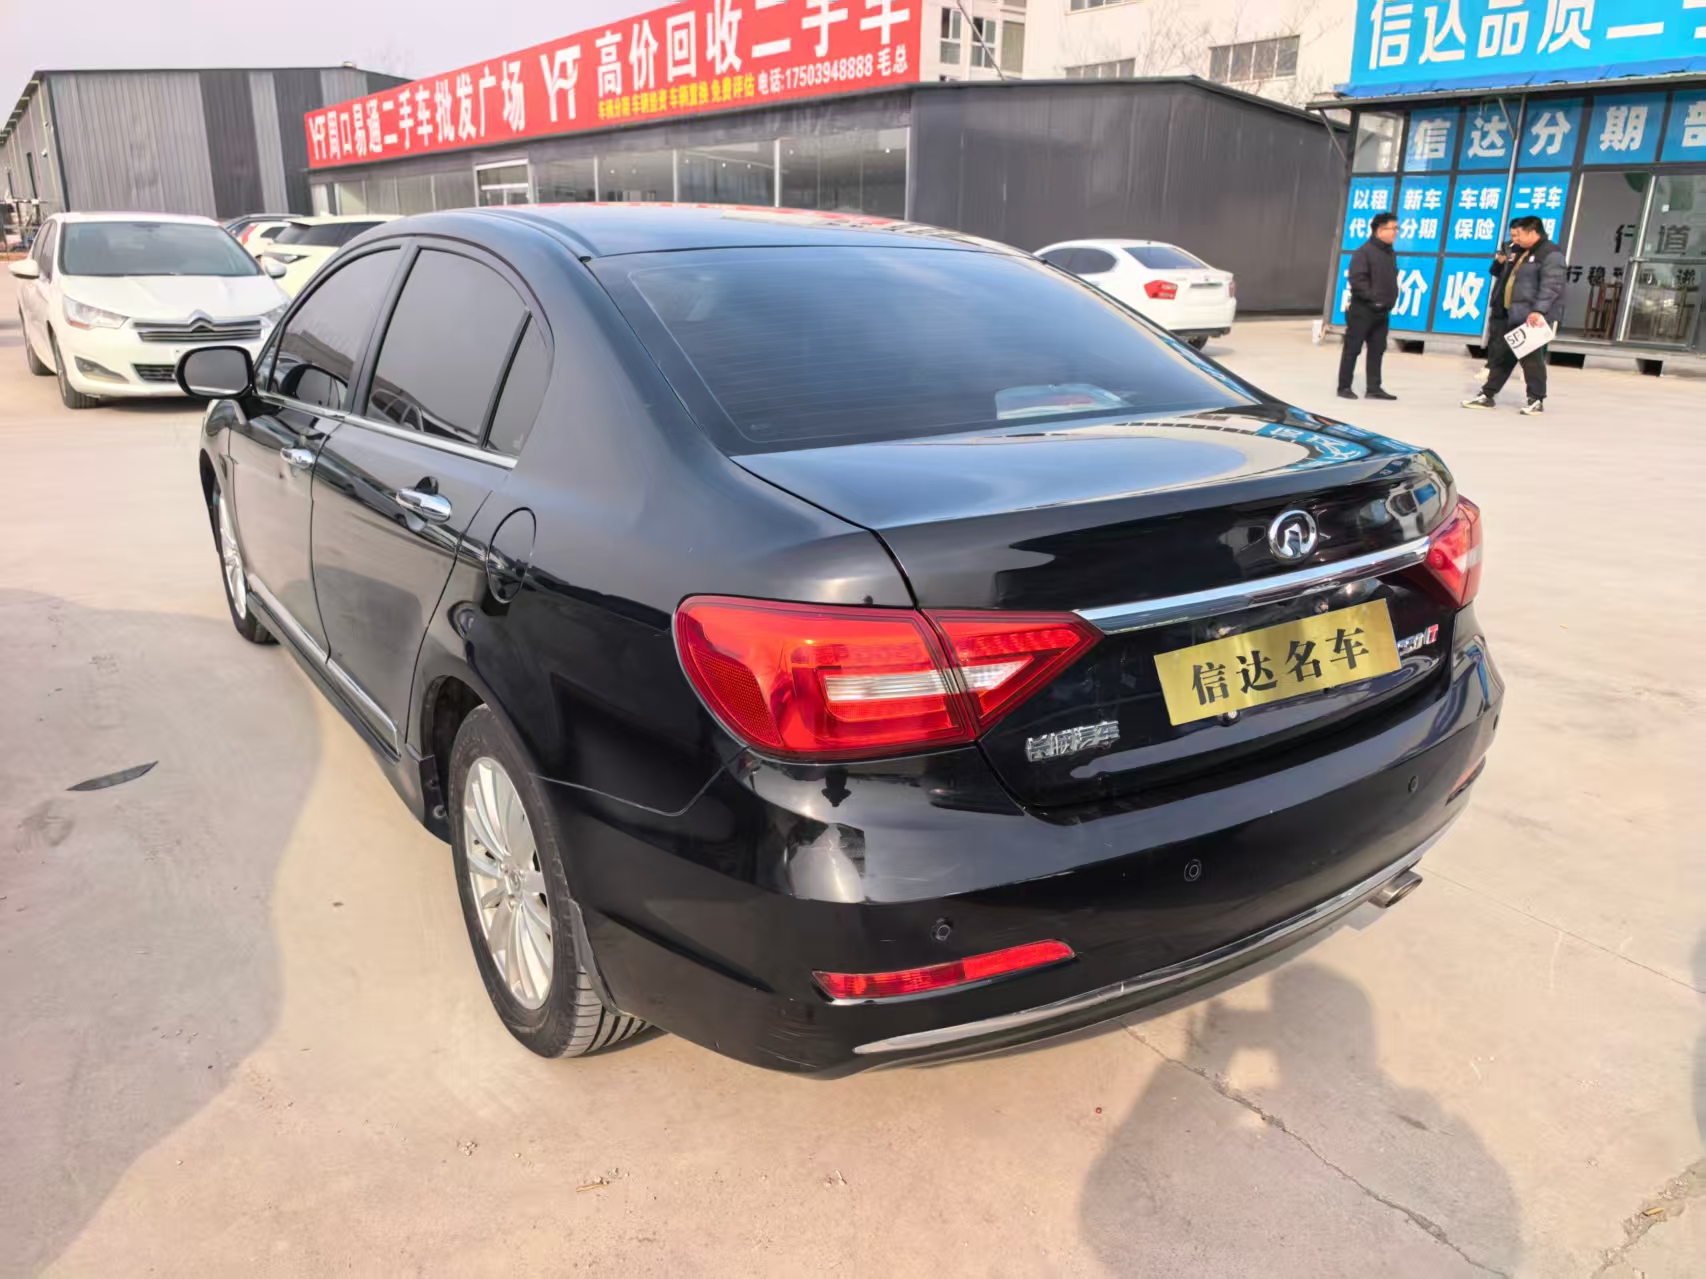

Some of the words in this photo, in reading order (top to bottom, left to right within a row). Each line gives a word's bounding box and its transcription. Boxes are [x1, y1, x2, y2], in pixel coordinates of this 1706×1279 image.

[878, 44, 908, 77] 毛总
[1353, 189, 1388, 210] 以租
[1403, 188, 1442, 211] 新车
[1458, 187, 1502, 210] 车辆
[1515, 186, 1563, 210] 二手车
[1349, 217, 1373, 239] 代
[1400, 217, 1438, 239] 分期
[1454, 217, 1496, 240] 保险
[1191, 627, 1369, 706] 信达名车
